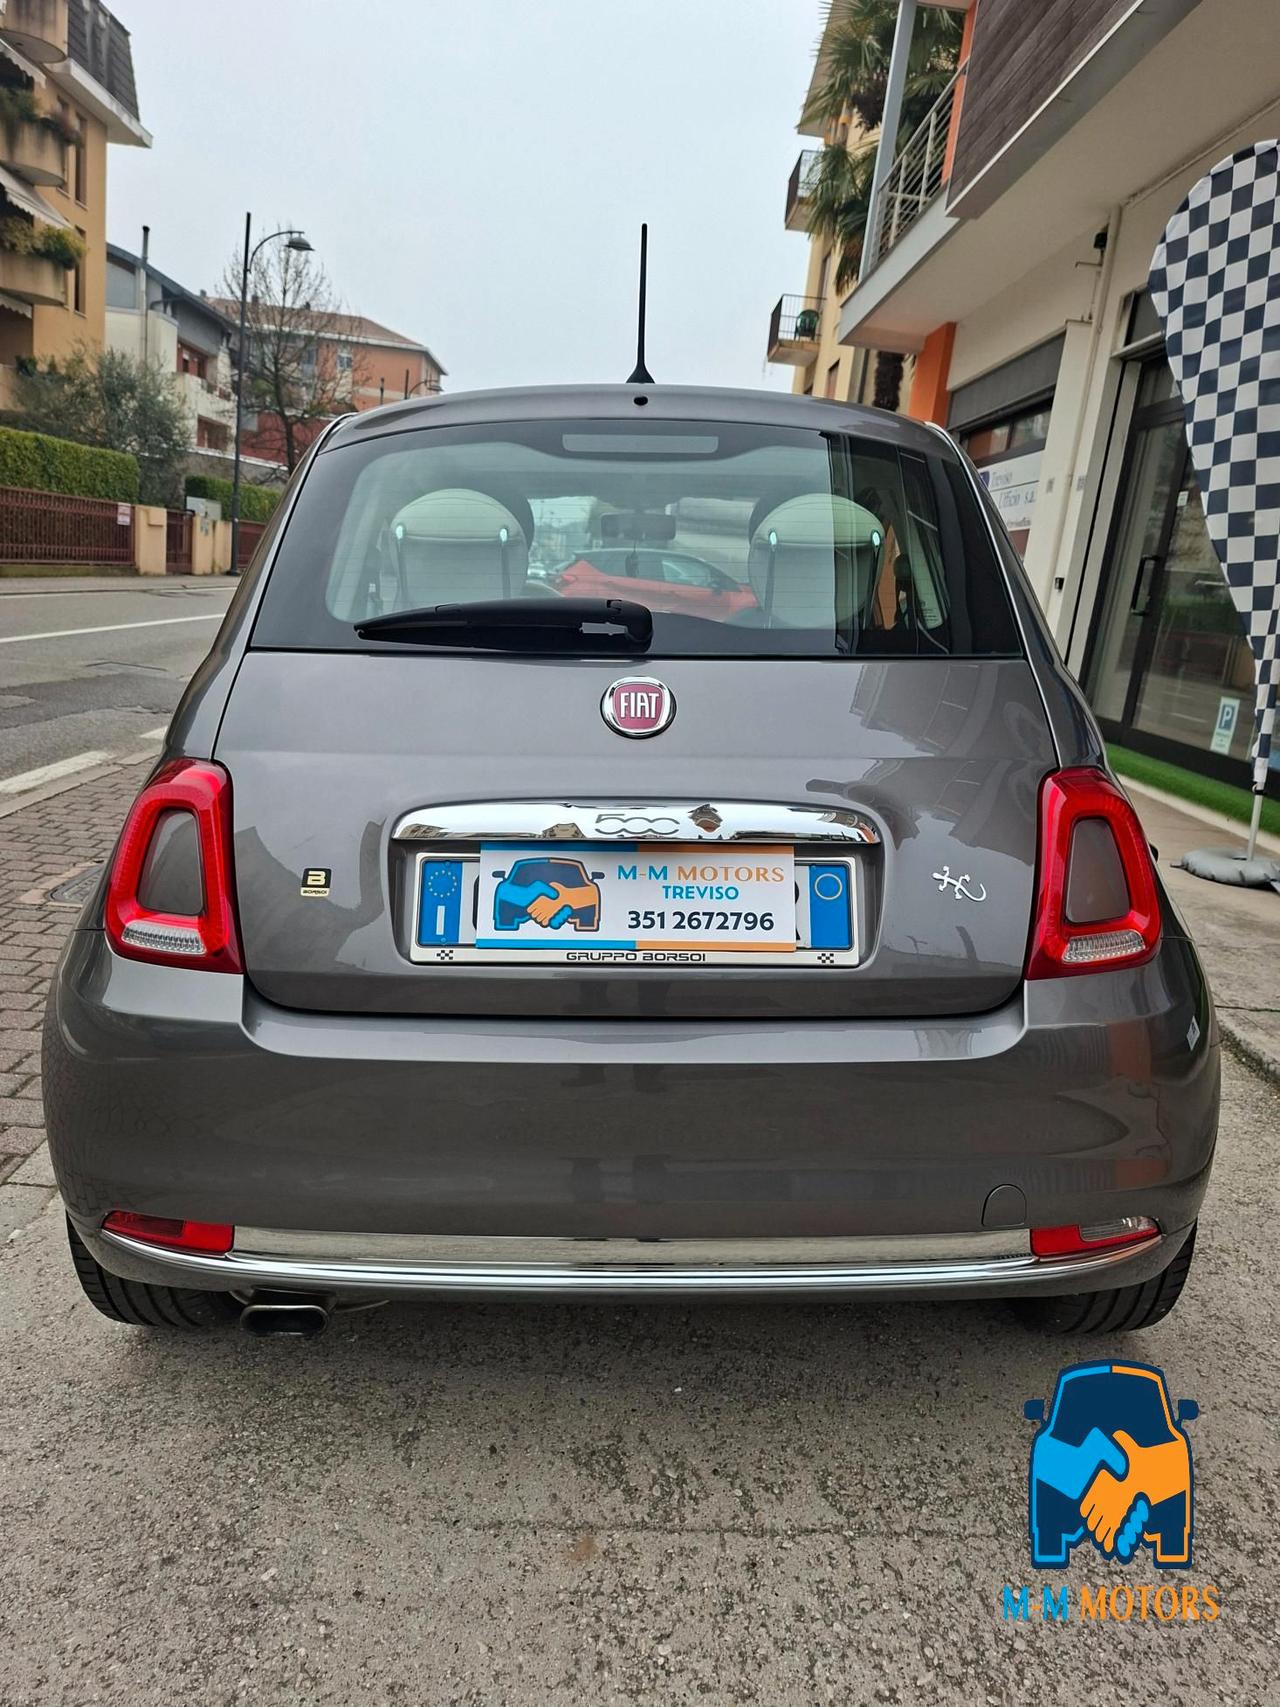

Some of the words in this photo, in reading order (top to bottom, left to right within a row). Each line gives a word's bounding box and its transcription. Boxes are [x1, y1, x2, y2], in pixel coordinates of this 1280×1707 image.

[620, 692, 660, 719] FIAT
[1221, 707, 1233, 727] P
[594, 813, 681, 835] 500
[307, 870, 326, 885] B
[617, 864, 668, 881] M-M
[677, 866, 785, 883] MOTORS
[662, 885, 739, 900] TREVISO
[628, 911, 665, 930] 351
[672, 911, 775, 931] 2672796
[566, 952, 638, 962] GRUPPO
[643, 952, 706, 962] BORSOI
